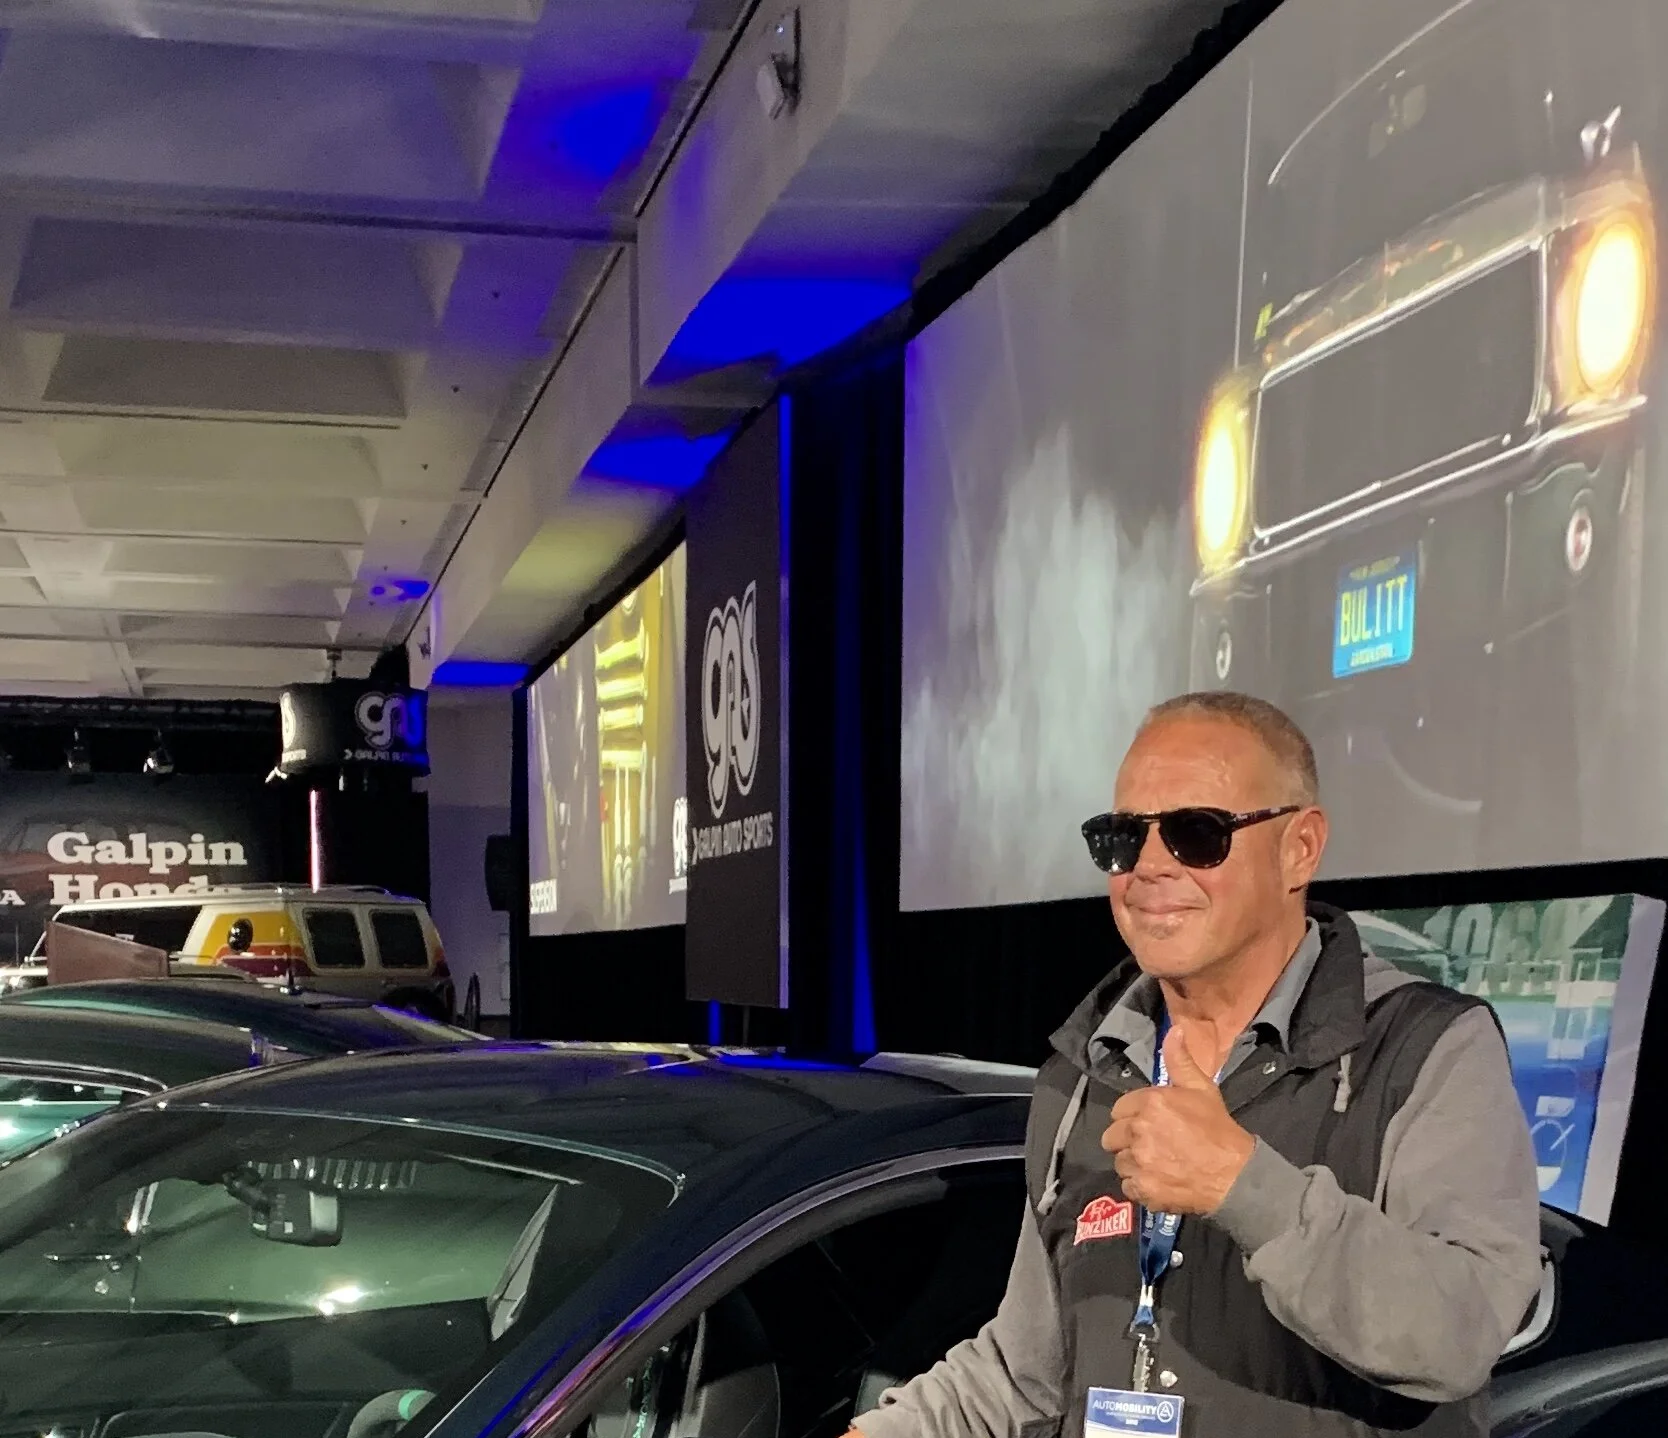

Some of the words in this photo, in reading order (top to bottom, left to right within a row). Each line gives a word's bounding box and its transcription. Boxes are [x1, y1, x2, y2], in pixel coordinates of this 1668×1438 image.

[1340, 574, 1408, 646] BULITT
[47, 831, 248, 874] Galpin
[48, 873, 242, 906] Hond
[1092, 1399, 1158, 1415] AUTOMOBILITY
